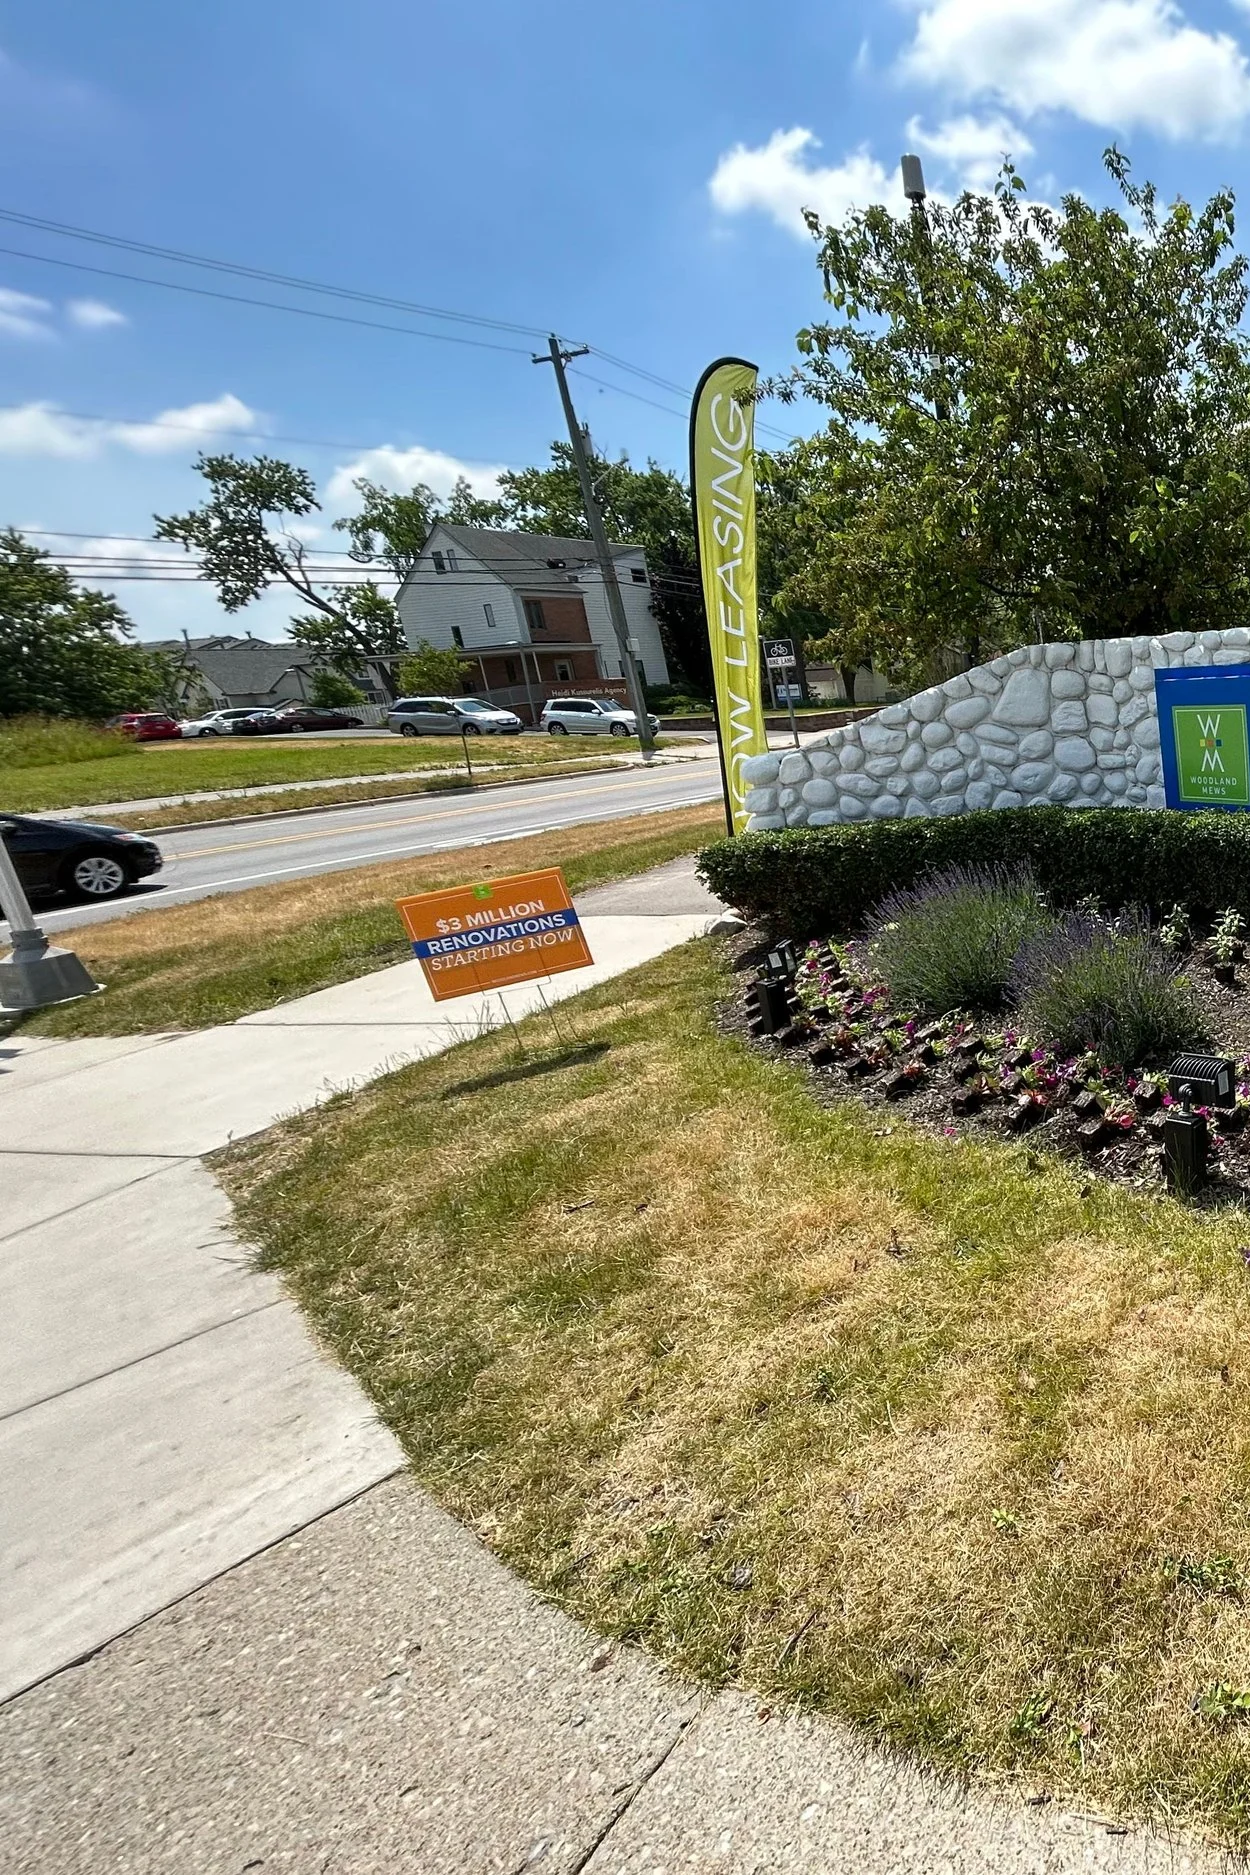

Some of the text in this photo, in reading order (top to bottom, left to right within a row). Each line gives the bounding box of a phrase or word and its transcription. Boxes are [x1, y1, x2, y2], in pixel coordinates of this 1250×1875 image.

[710, 393, 748, 667] LEASING
[768, 656, 793, 666] BIKE LANE
[551, 688, 570, 697] Heidi
[604, 686, 627, 694] Agency
[1196, 714, 1221, 738] W
[1190, 776, 1237, 786] WOODLAND
[1202, 786, 1226, 796] MEWS
[435, 899, 545, 935] $3 MILLION
[426, 913, 567, 955] RENOVATIONS
[431, 927, 573, 971] STARTING NOW
